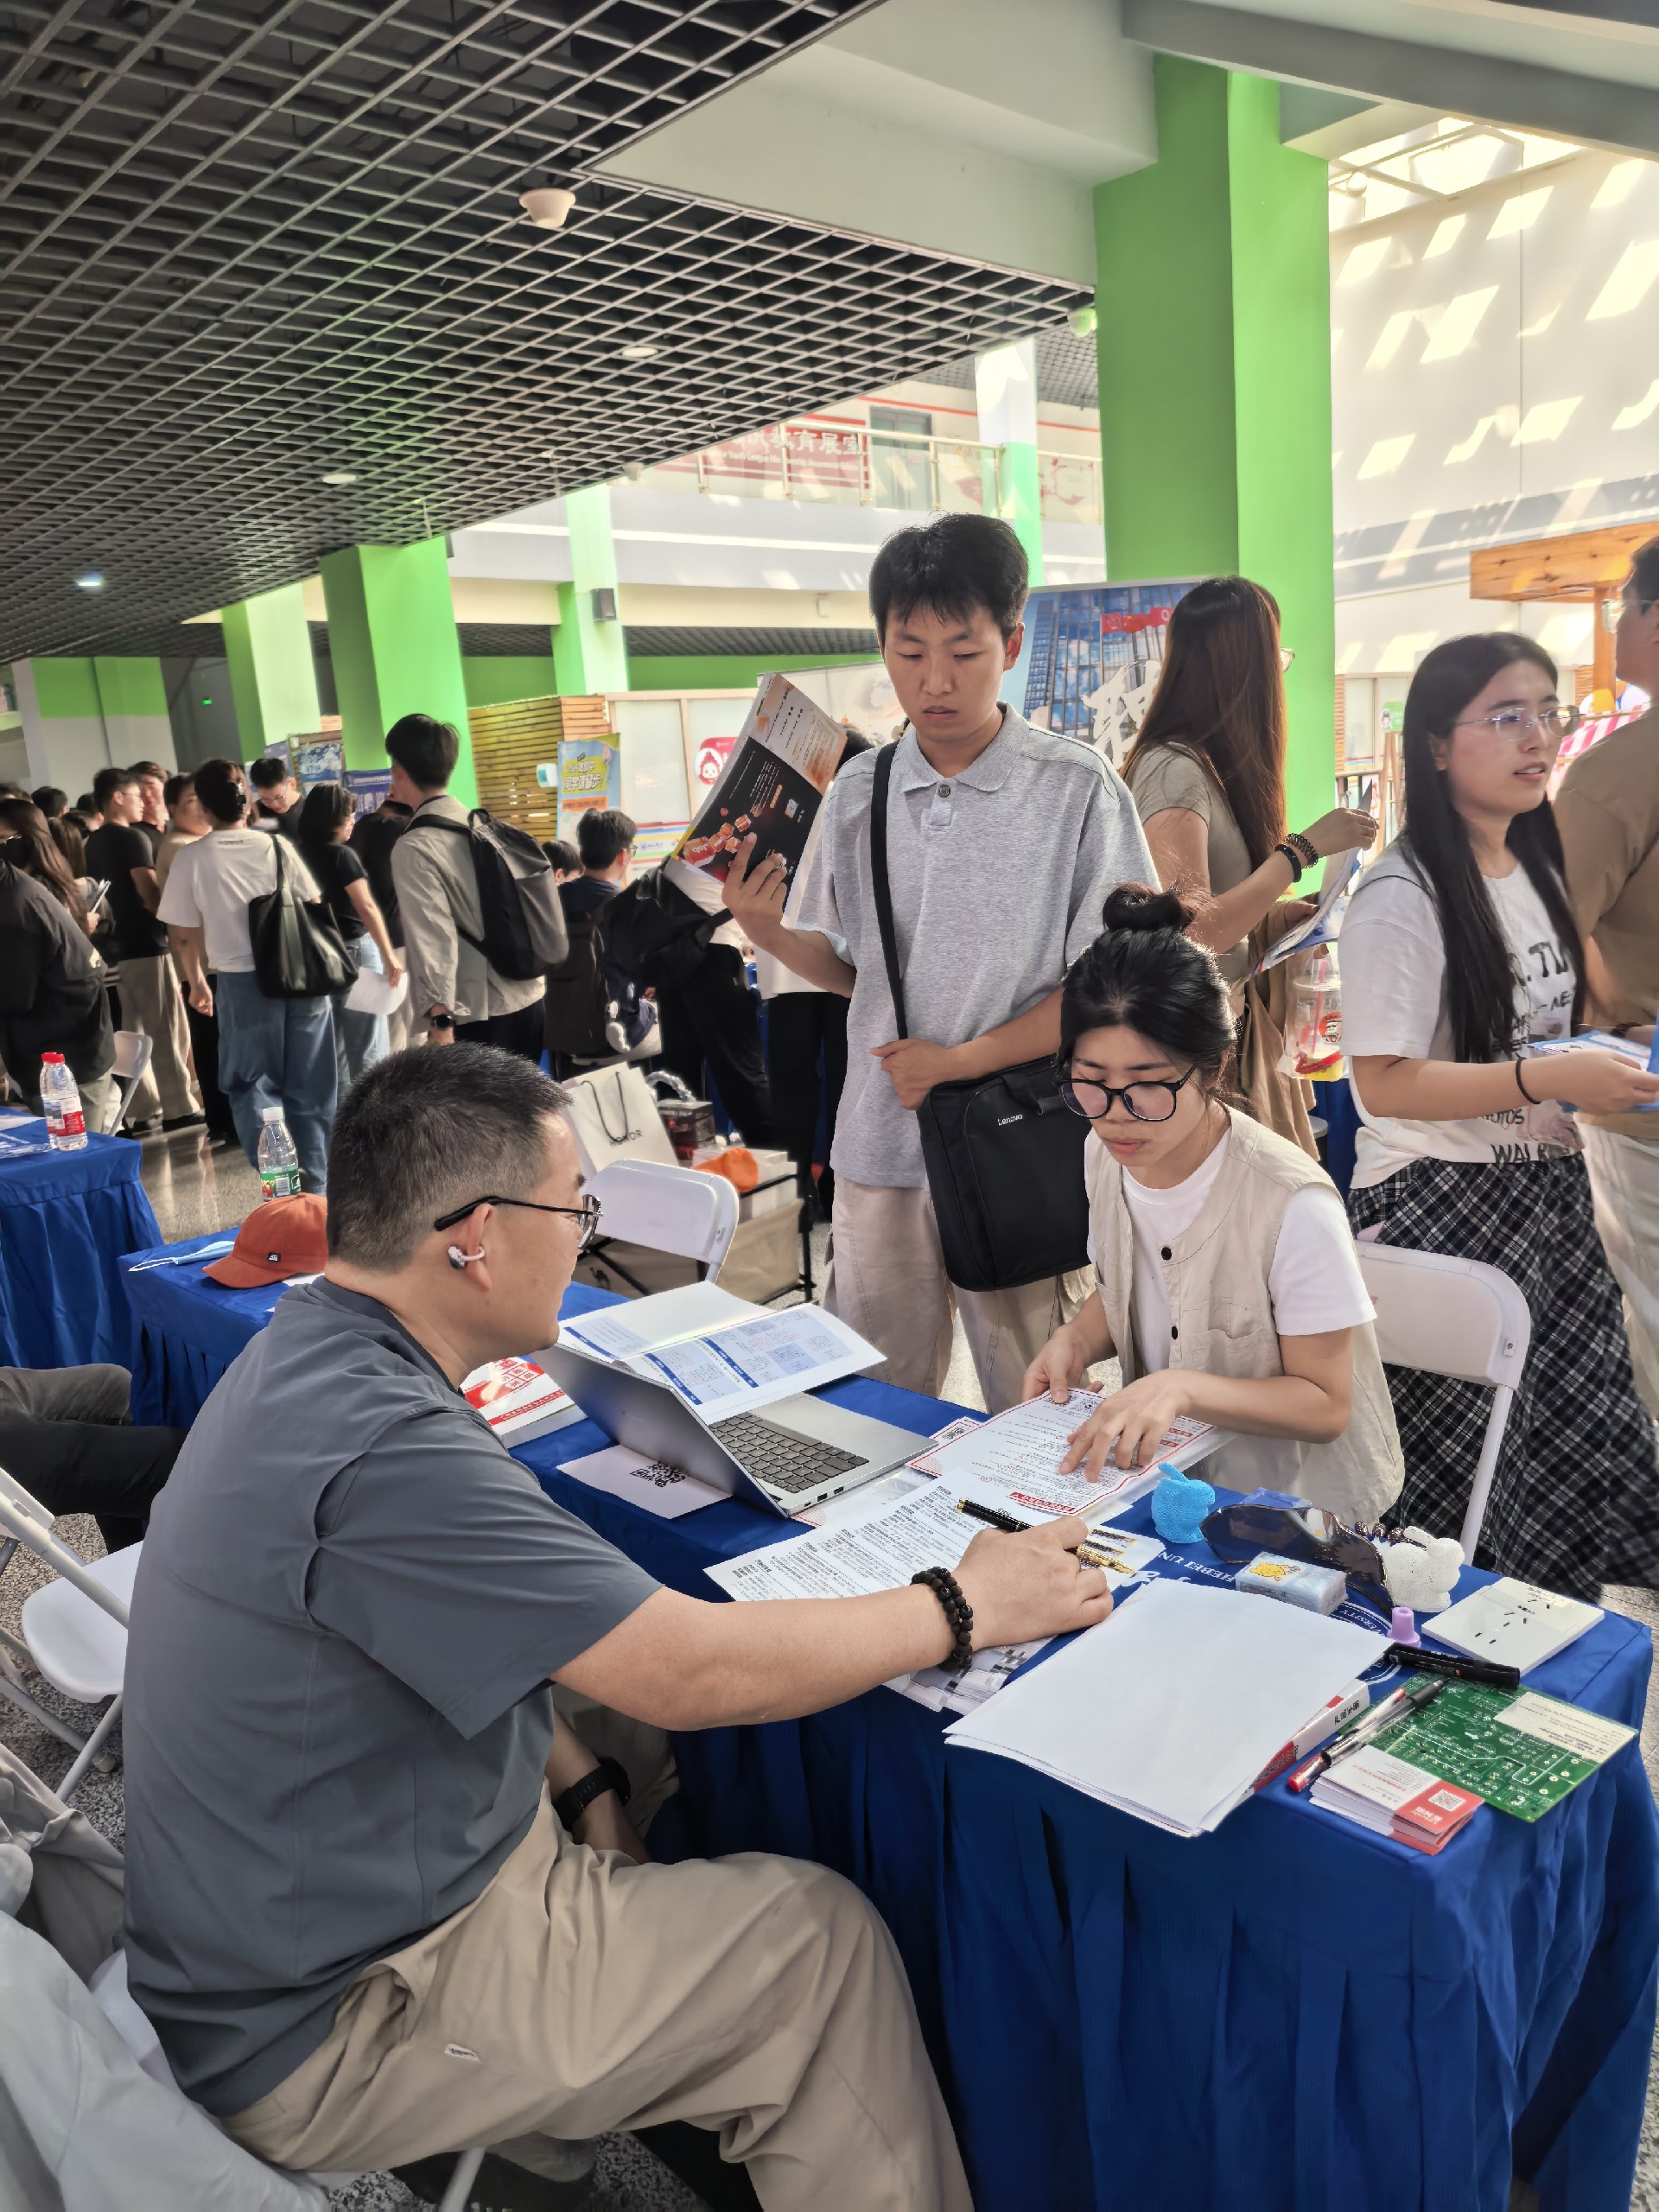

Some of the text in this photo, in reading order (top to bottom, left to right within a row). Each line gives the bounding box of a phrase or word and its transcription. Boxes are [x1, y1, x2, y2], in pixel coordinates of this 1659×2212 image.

[691, 842, 708, 855] Job
[997, 1114, 1023, 1126] Lenovo
[1184, 1560, 1236, 1583] HEBEI
[1338, 1607, 1384, 1636] VERSITY
